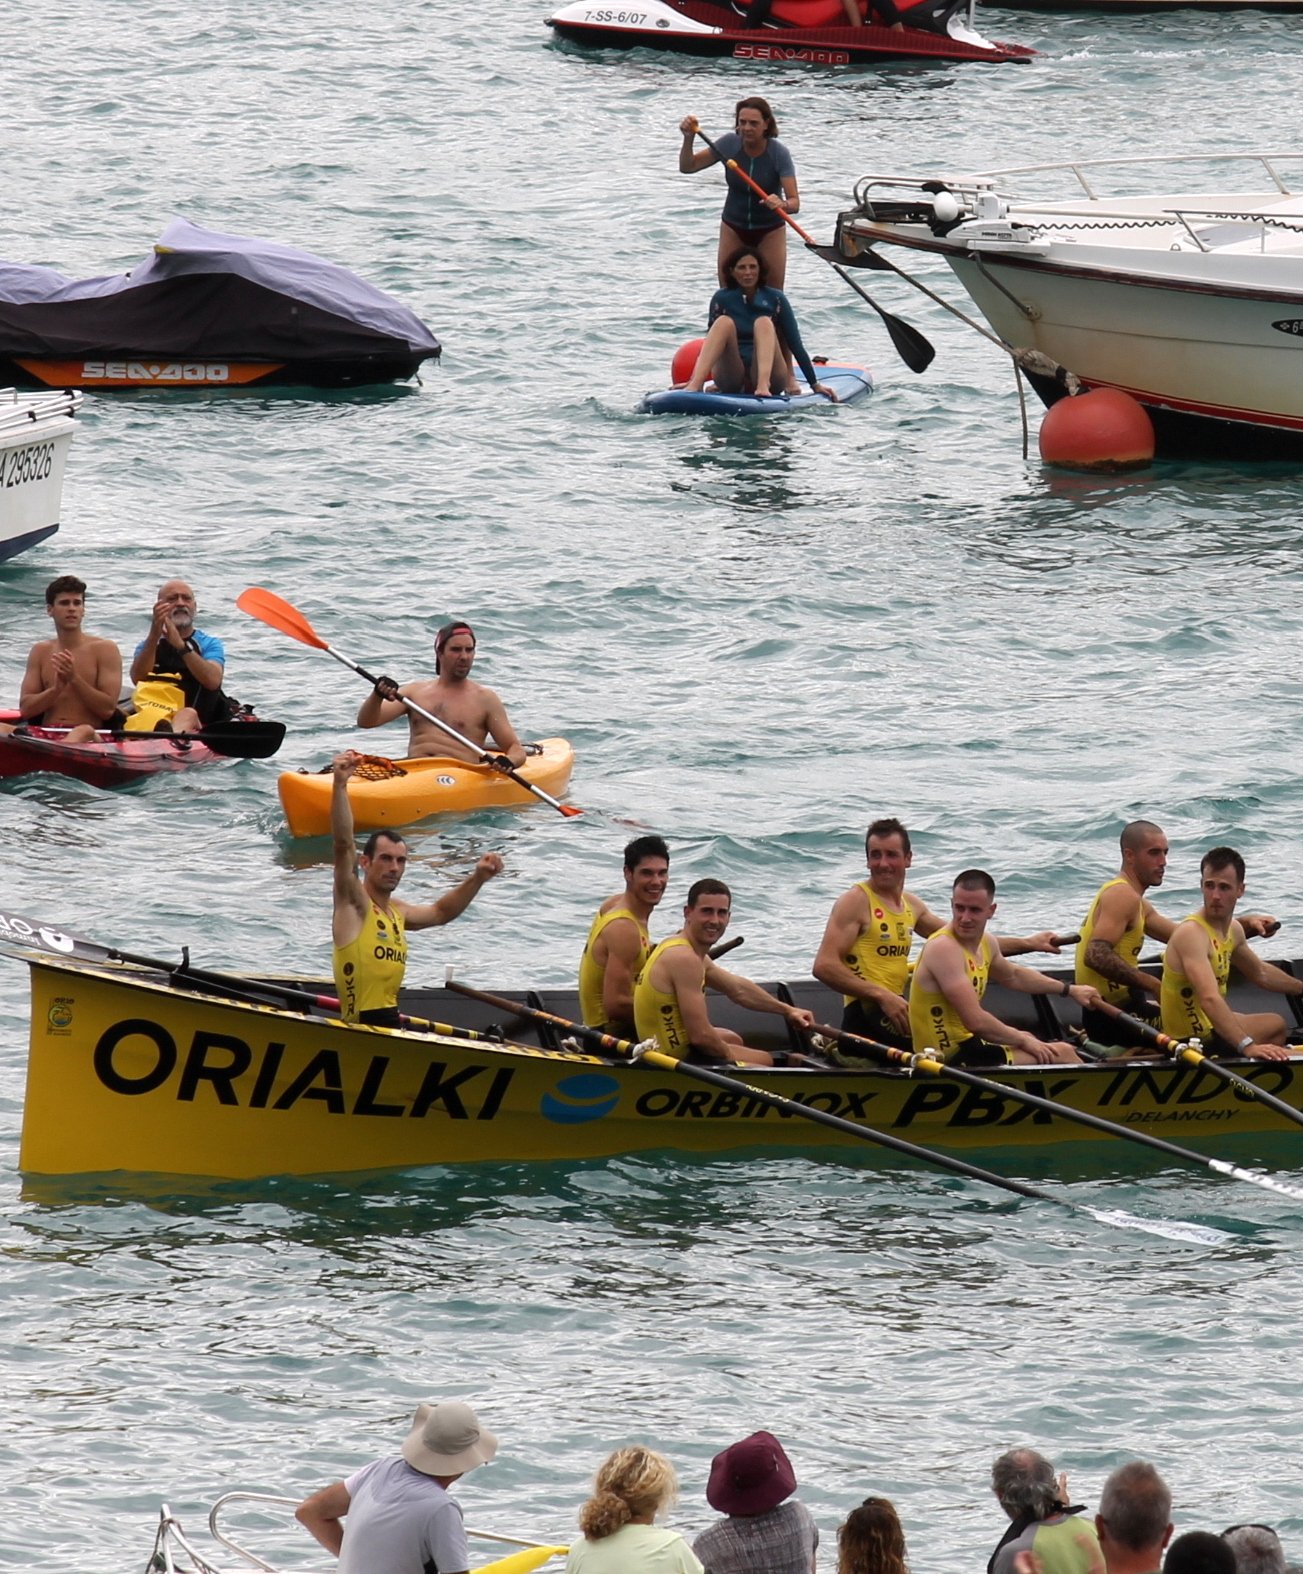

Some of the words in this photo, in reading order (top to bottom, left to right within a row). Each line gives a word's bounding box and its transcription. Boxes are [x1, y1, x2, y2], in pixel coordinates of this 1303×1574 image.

[584, 10, 647, 25] 7-SS-6/07
[7, 442, 55, 488] 295326
[374, 945, 407, 965] ORIAL
[93, 1018, 516, 1120] ORIALKI
[1097, 1066, 1294, 1106] INDO
[635, 1088, 879, 1118] ORBINOX
[892, 1079, 1080, 1128] PBX
[1125, 1108, 1240, 1123] DELANCHY
